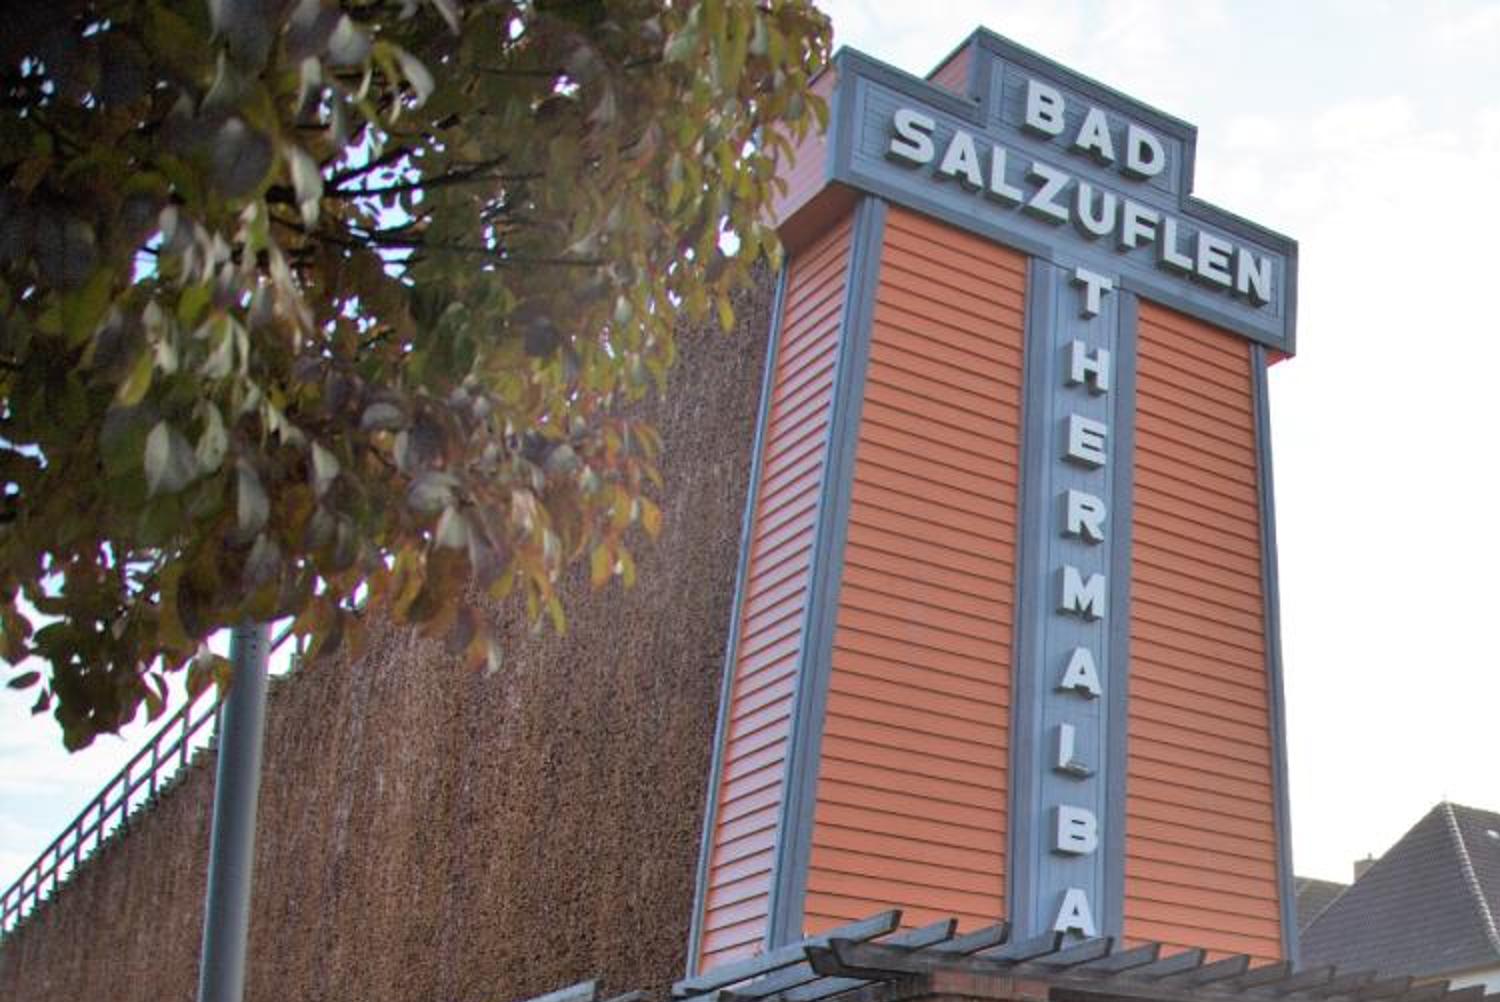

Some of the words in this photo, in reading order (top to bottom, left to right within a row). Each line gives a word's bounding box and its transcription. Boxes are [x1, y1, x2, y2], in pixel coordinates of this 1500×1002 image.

[887, 108, 1273, 305] SALZUFLEN
[1022, 79, 1166, 178] BAD
[1052, 267, 1113, 938] THERMALBA
